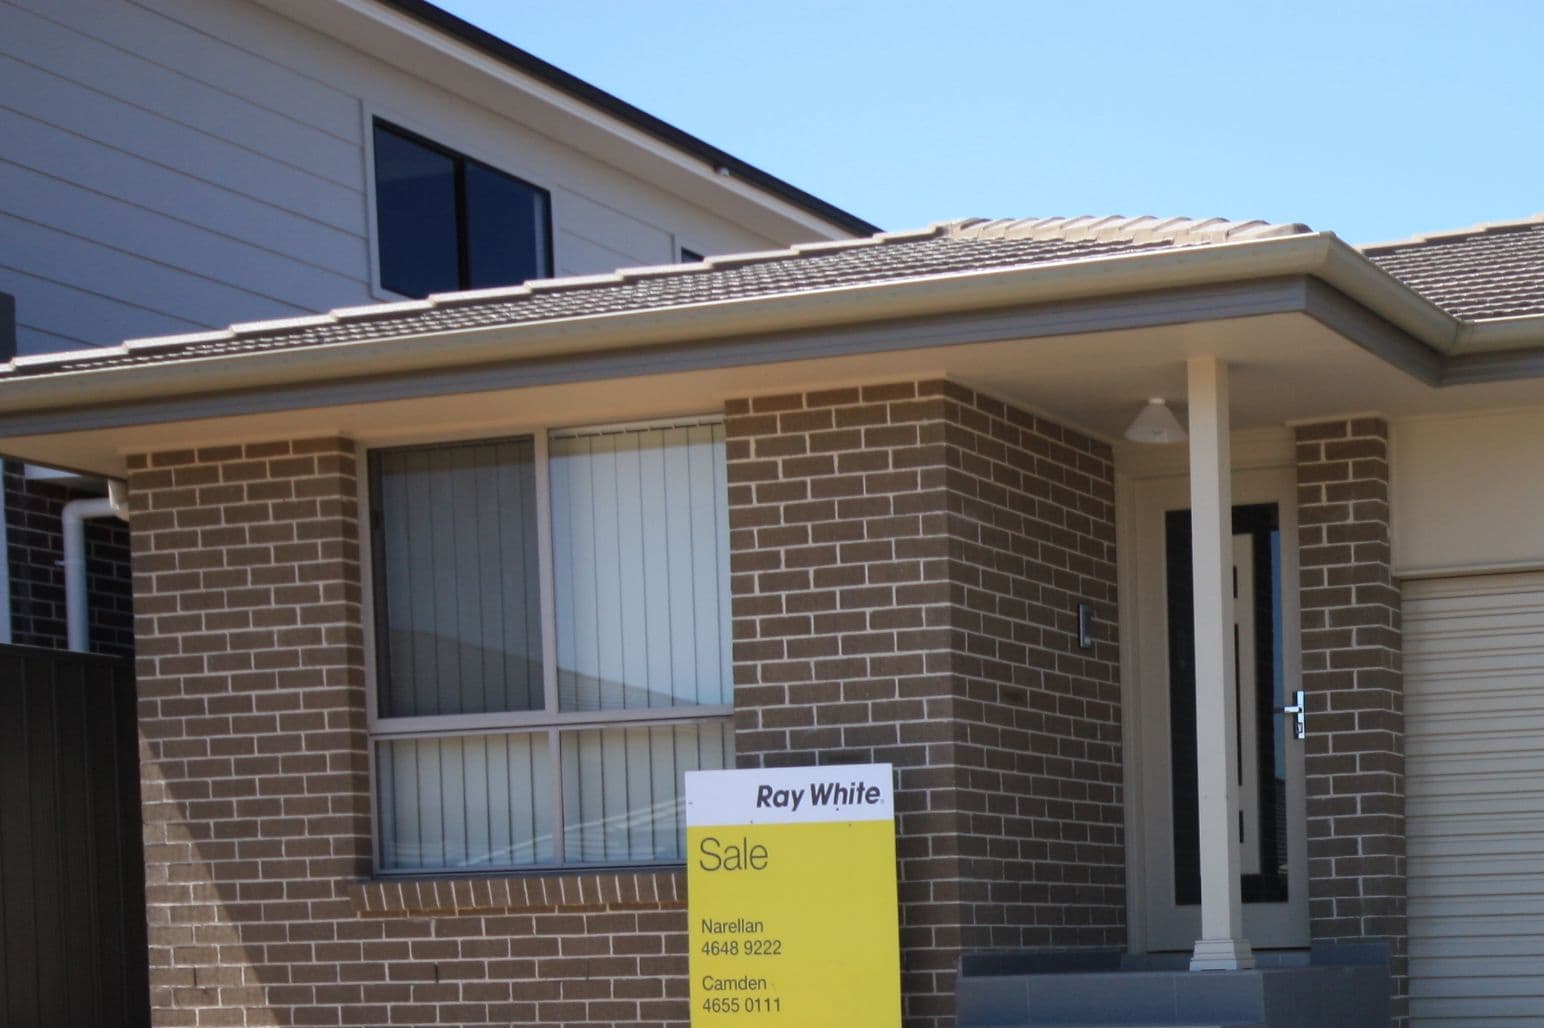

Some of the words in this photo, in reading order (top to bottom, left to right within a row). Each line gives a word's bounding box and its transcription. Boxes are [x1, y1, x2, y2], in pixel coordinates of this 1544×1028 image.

[757, 784, 805, 811] Ray
[811, 782, 881, 806] White
[699, 837, 769, 871] Sale
[702, 919, 763, 933] Narellan
[702, 941, 739, 956] 4648
[744, 940, 781, 955] 9222
[702, 976, 767, 991] Camden
[702, 998, 739, 1013] 4655
[744, 997, 781, 1012] 0111
